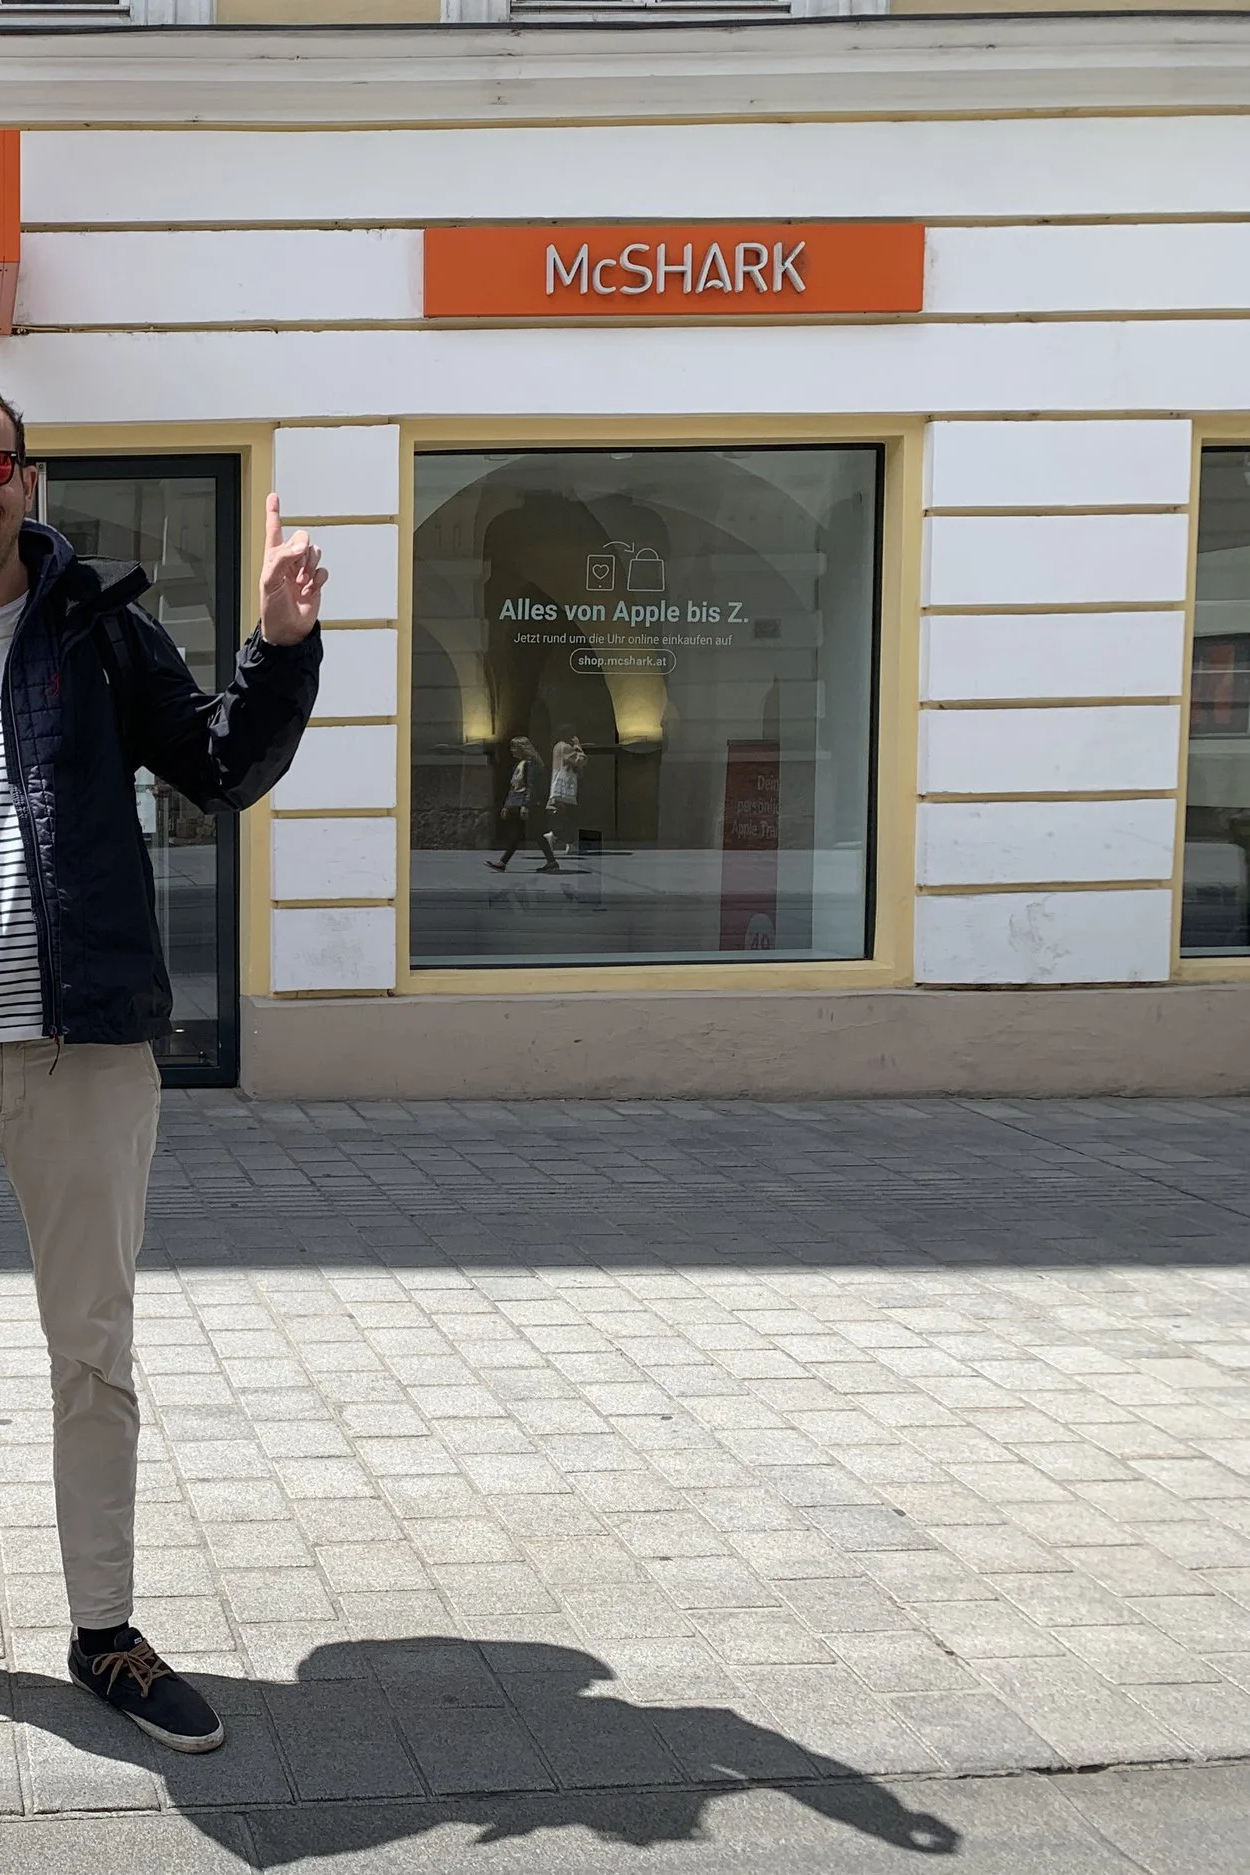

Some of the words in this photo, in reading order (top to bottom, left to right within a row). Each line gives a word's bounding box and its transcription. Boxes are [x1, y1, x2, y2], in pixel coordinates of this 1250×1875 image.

[545, 240, 807, 295] McSHARK
[499, 598, 558, 621] Alles
[564, 604, 606, 621] von
[612, 600, 680, 627] Apple
[687, 600, 721, 622] bis
[727, 601, 749, 623] Z.
[513, 632, 540, 644] Jetzt
[542, 632, 567, 644] rund
[569, 634, 586, 644] um
[588, 633, 605, 645] die
[607, 633, 625, 645] Uhr
[628, 634, 659, 645] online
[662, 634, 712, 646] einkaufen
[715, 635, 733, 646] auf
[578, 655, 667, 668] shop.mcshark.at
[731, 820, 758, 838] Apple
